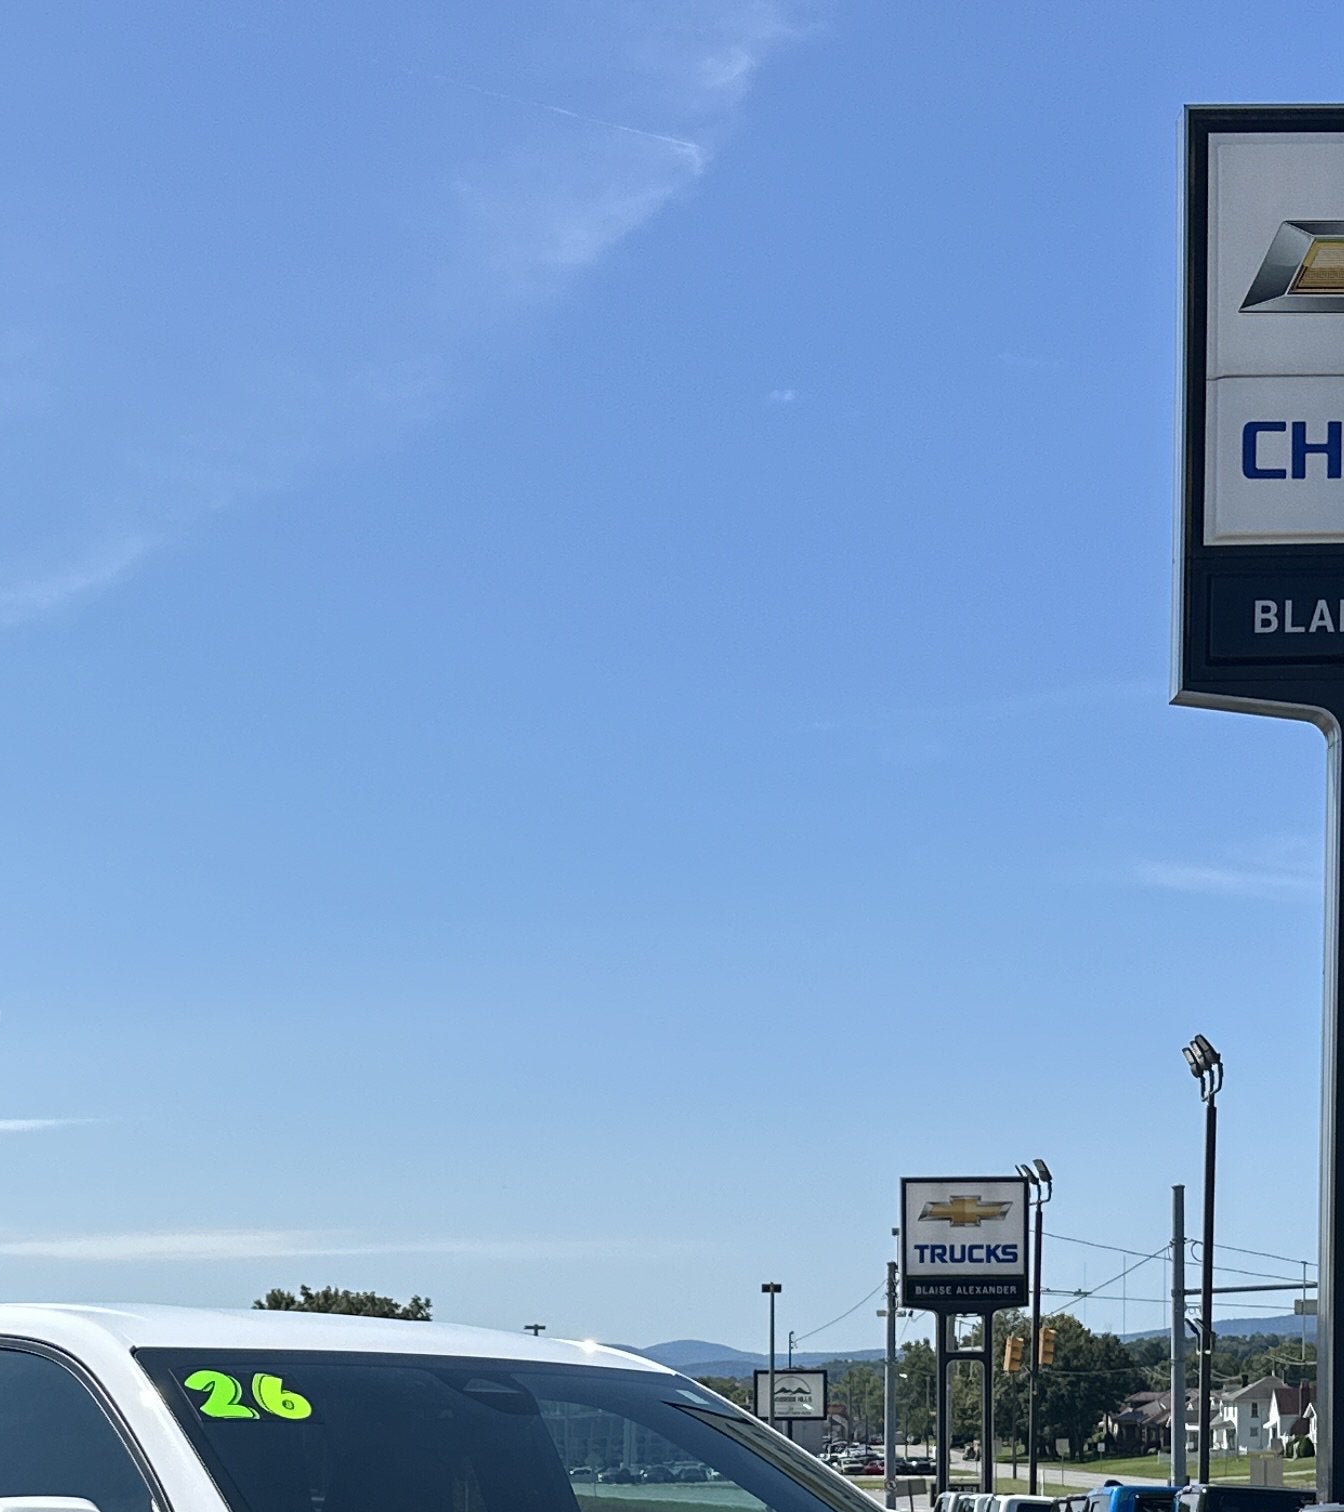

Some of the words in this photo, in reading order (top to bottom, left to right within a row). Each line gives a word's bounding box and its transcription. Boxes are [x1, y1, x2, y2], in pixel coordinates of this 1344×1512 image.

[913, 1243, 1019, 1264] TRUCKS
[914, 1285, 953, 1296] BLAISE
[956, 1284, 1018, 1295] ALEXANDER
[183, 1369, 313, 1420] 26
